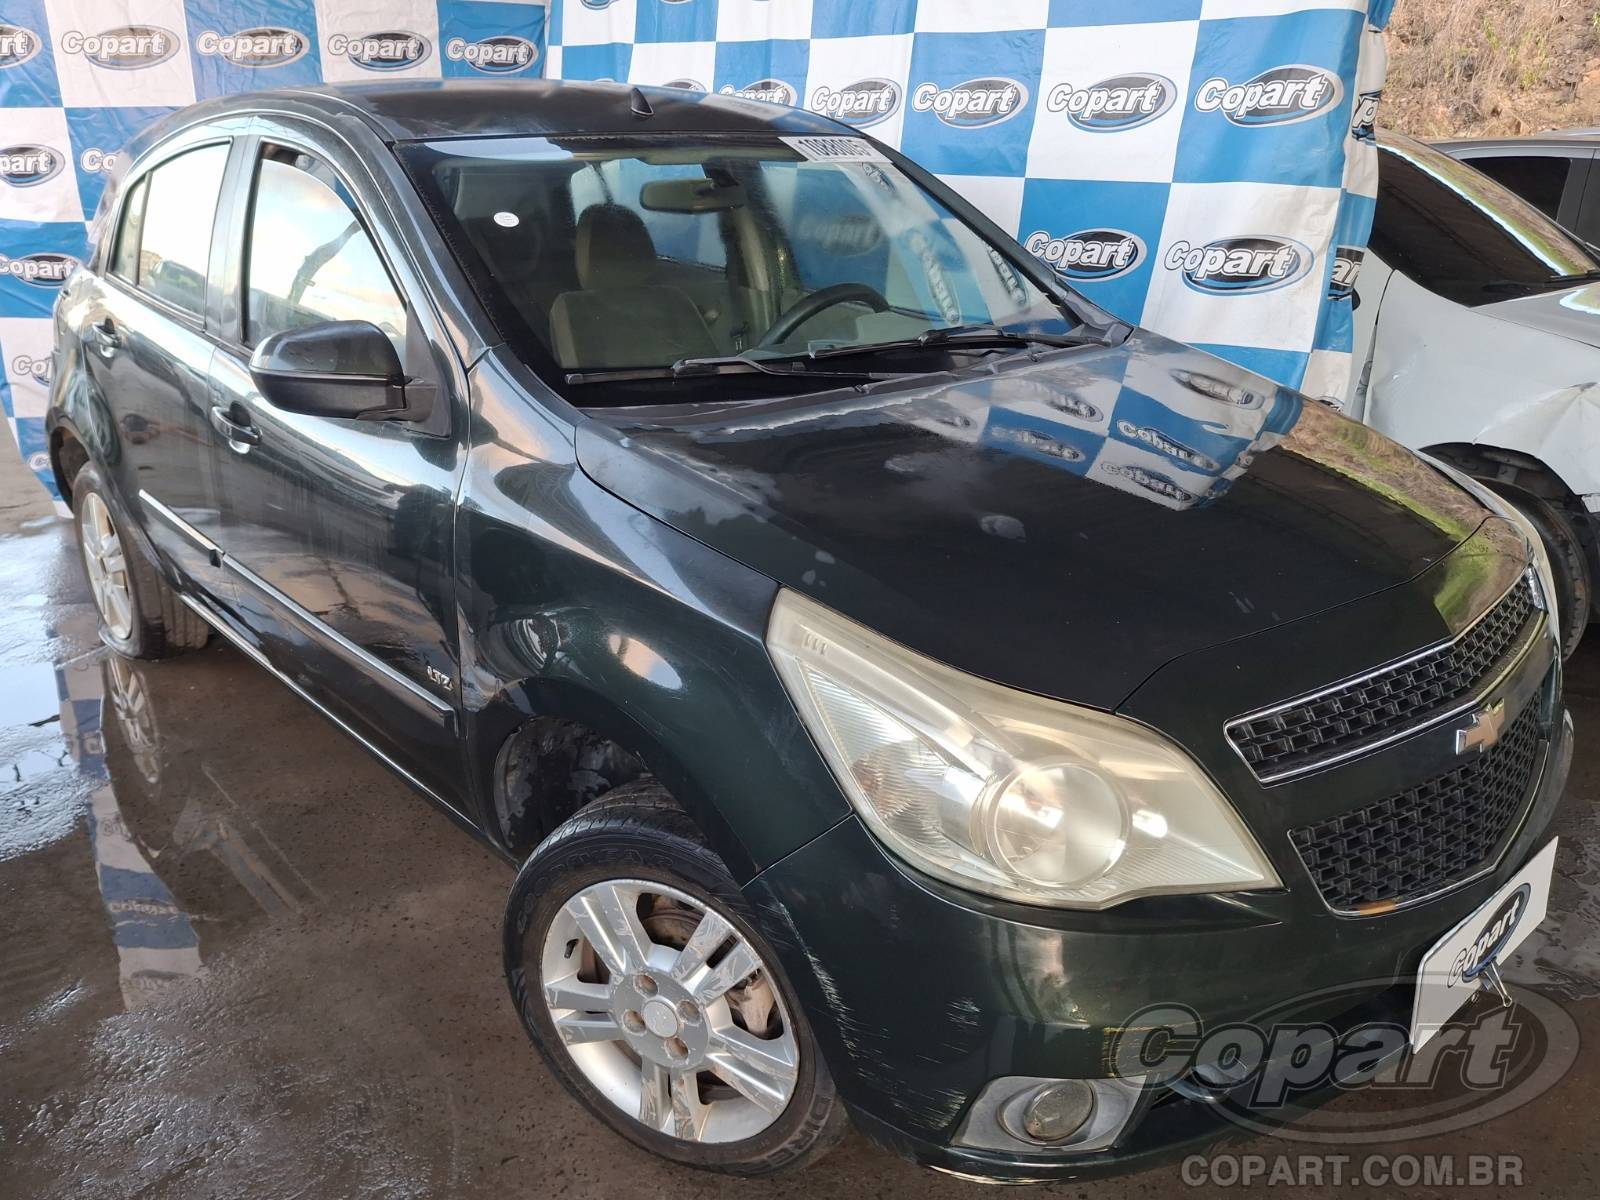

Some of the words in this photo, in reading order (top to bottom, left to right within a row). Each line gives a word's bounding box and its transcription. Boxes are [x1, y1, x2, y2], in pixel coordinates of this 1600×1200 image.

[61, 31, 164, 60] Copart
[196, 31, 297, 59] Copart
[327, 33, 422, 61] Copart
[445, 38, 530, 65] Copart
[810, 85, 892, 118] Copart
[911, 81, 1015, 119] Copart
[1046, 79, 1165, 120] Copart
[1194, 71, 1330, 119] Copart
[0, 150, 51, 174] part
[1023, 231, 1136, 270] Copart
[1163, 240, 1298, 281] Copart
[1447, 897, 1520, 988] Copart
